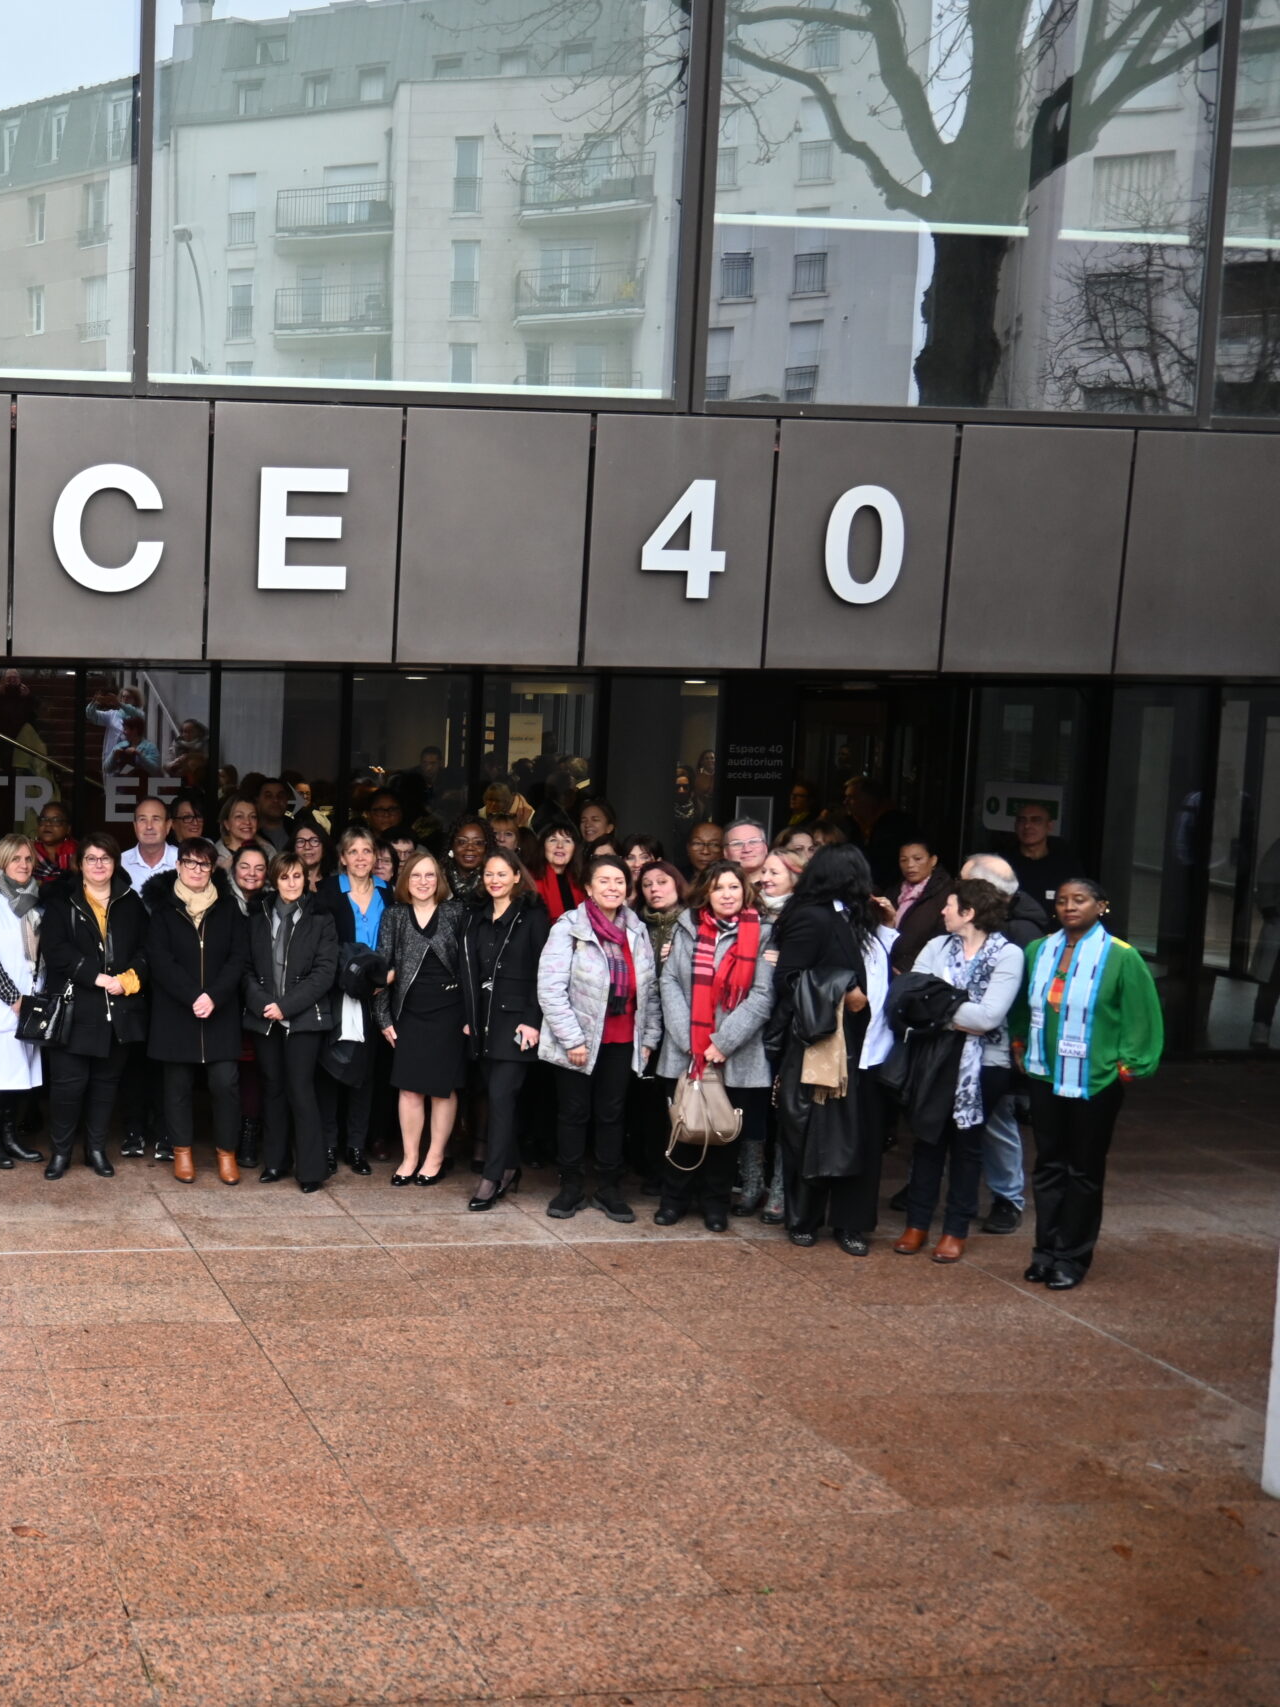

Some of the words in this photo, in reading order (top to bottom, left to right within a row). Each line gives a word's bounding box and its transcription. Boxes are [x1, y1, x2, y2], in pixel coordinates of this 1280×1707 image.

[641, 479, 905, 604] 40
[729, 744, 766, 754] Espace
[768, 744, 783, 753] 40
[727, 757, 783, 766] auditorium
[727, 771, 752, 779] accès
[754, 771, 782, 780] public
